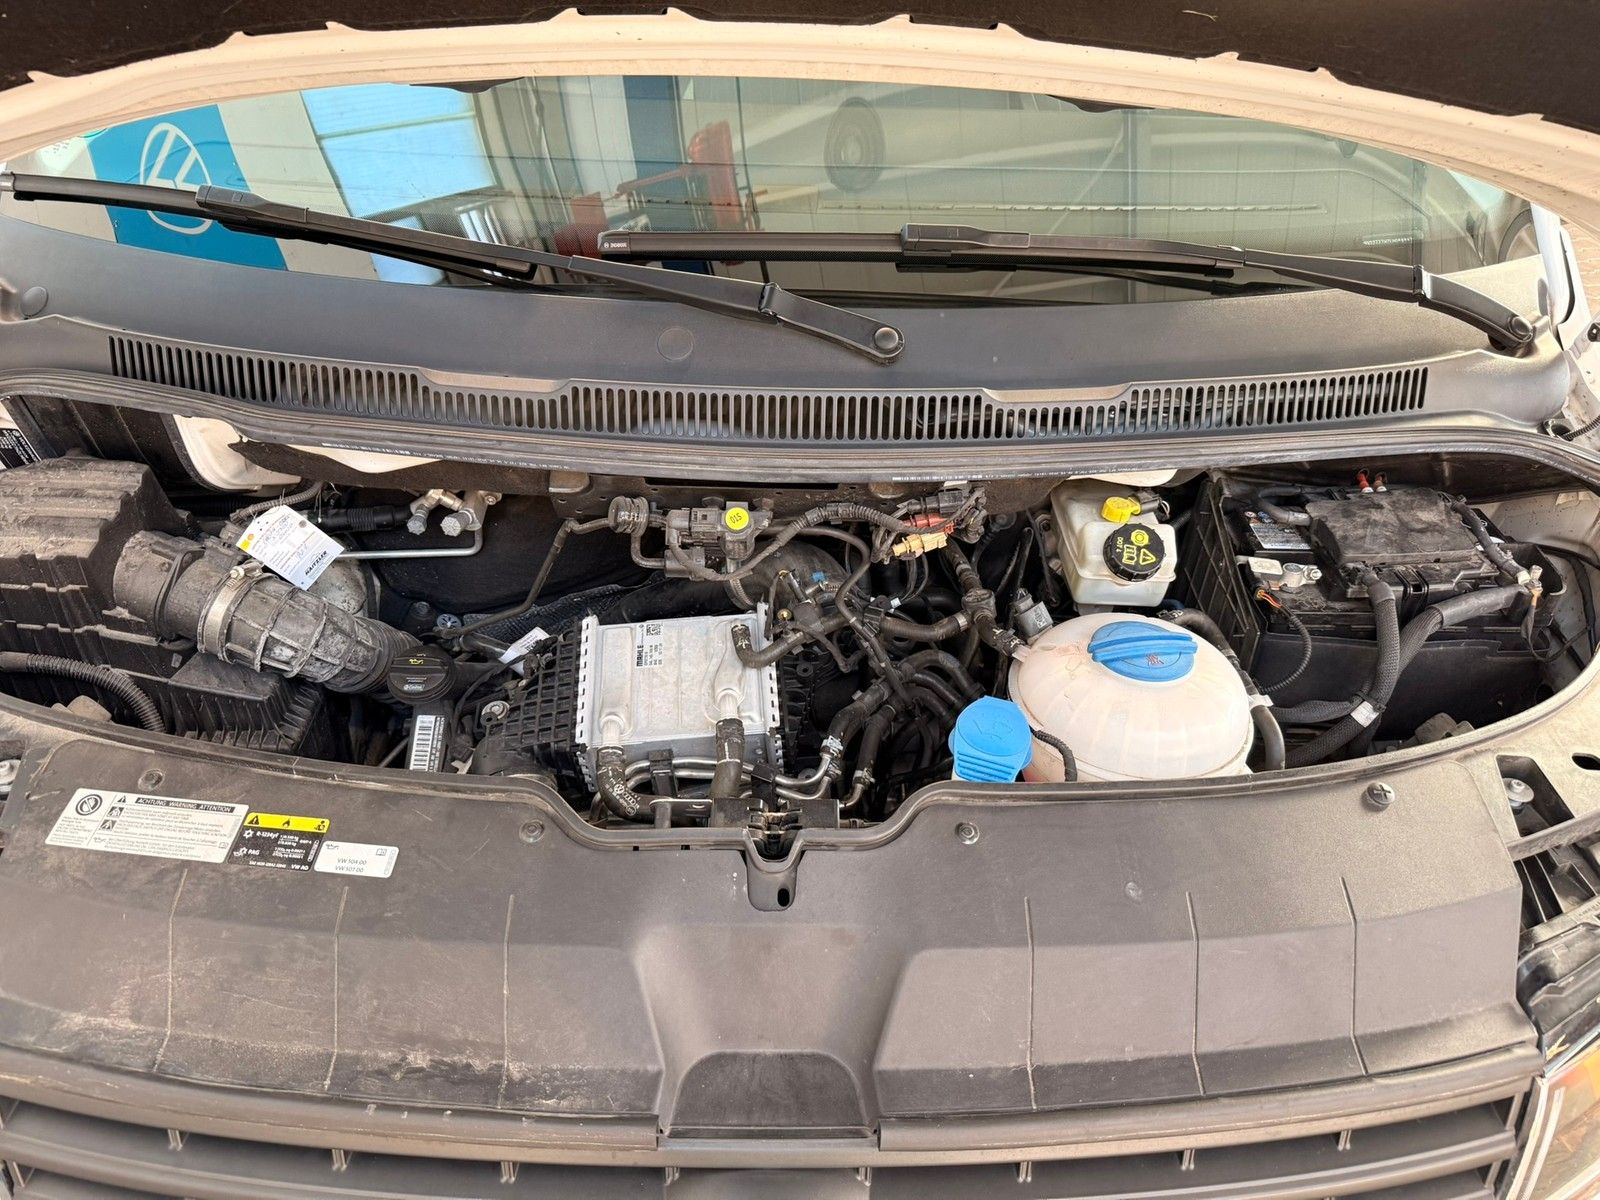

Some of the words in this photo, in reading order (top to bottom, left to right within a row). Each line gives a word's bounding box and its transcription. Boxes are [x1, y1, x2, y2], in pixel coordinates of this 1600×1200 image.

[729, 512, 743, 524] 015
[1116, 536, 1124, 548] DOT
[636, 644, 644, 667] MAHLE
[137, 798, 166, 806] ACHTUNG
[169, 801, 198, 809] WARNING
[199, 804, 231, 812] ATTENTION
